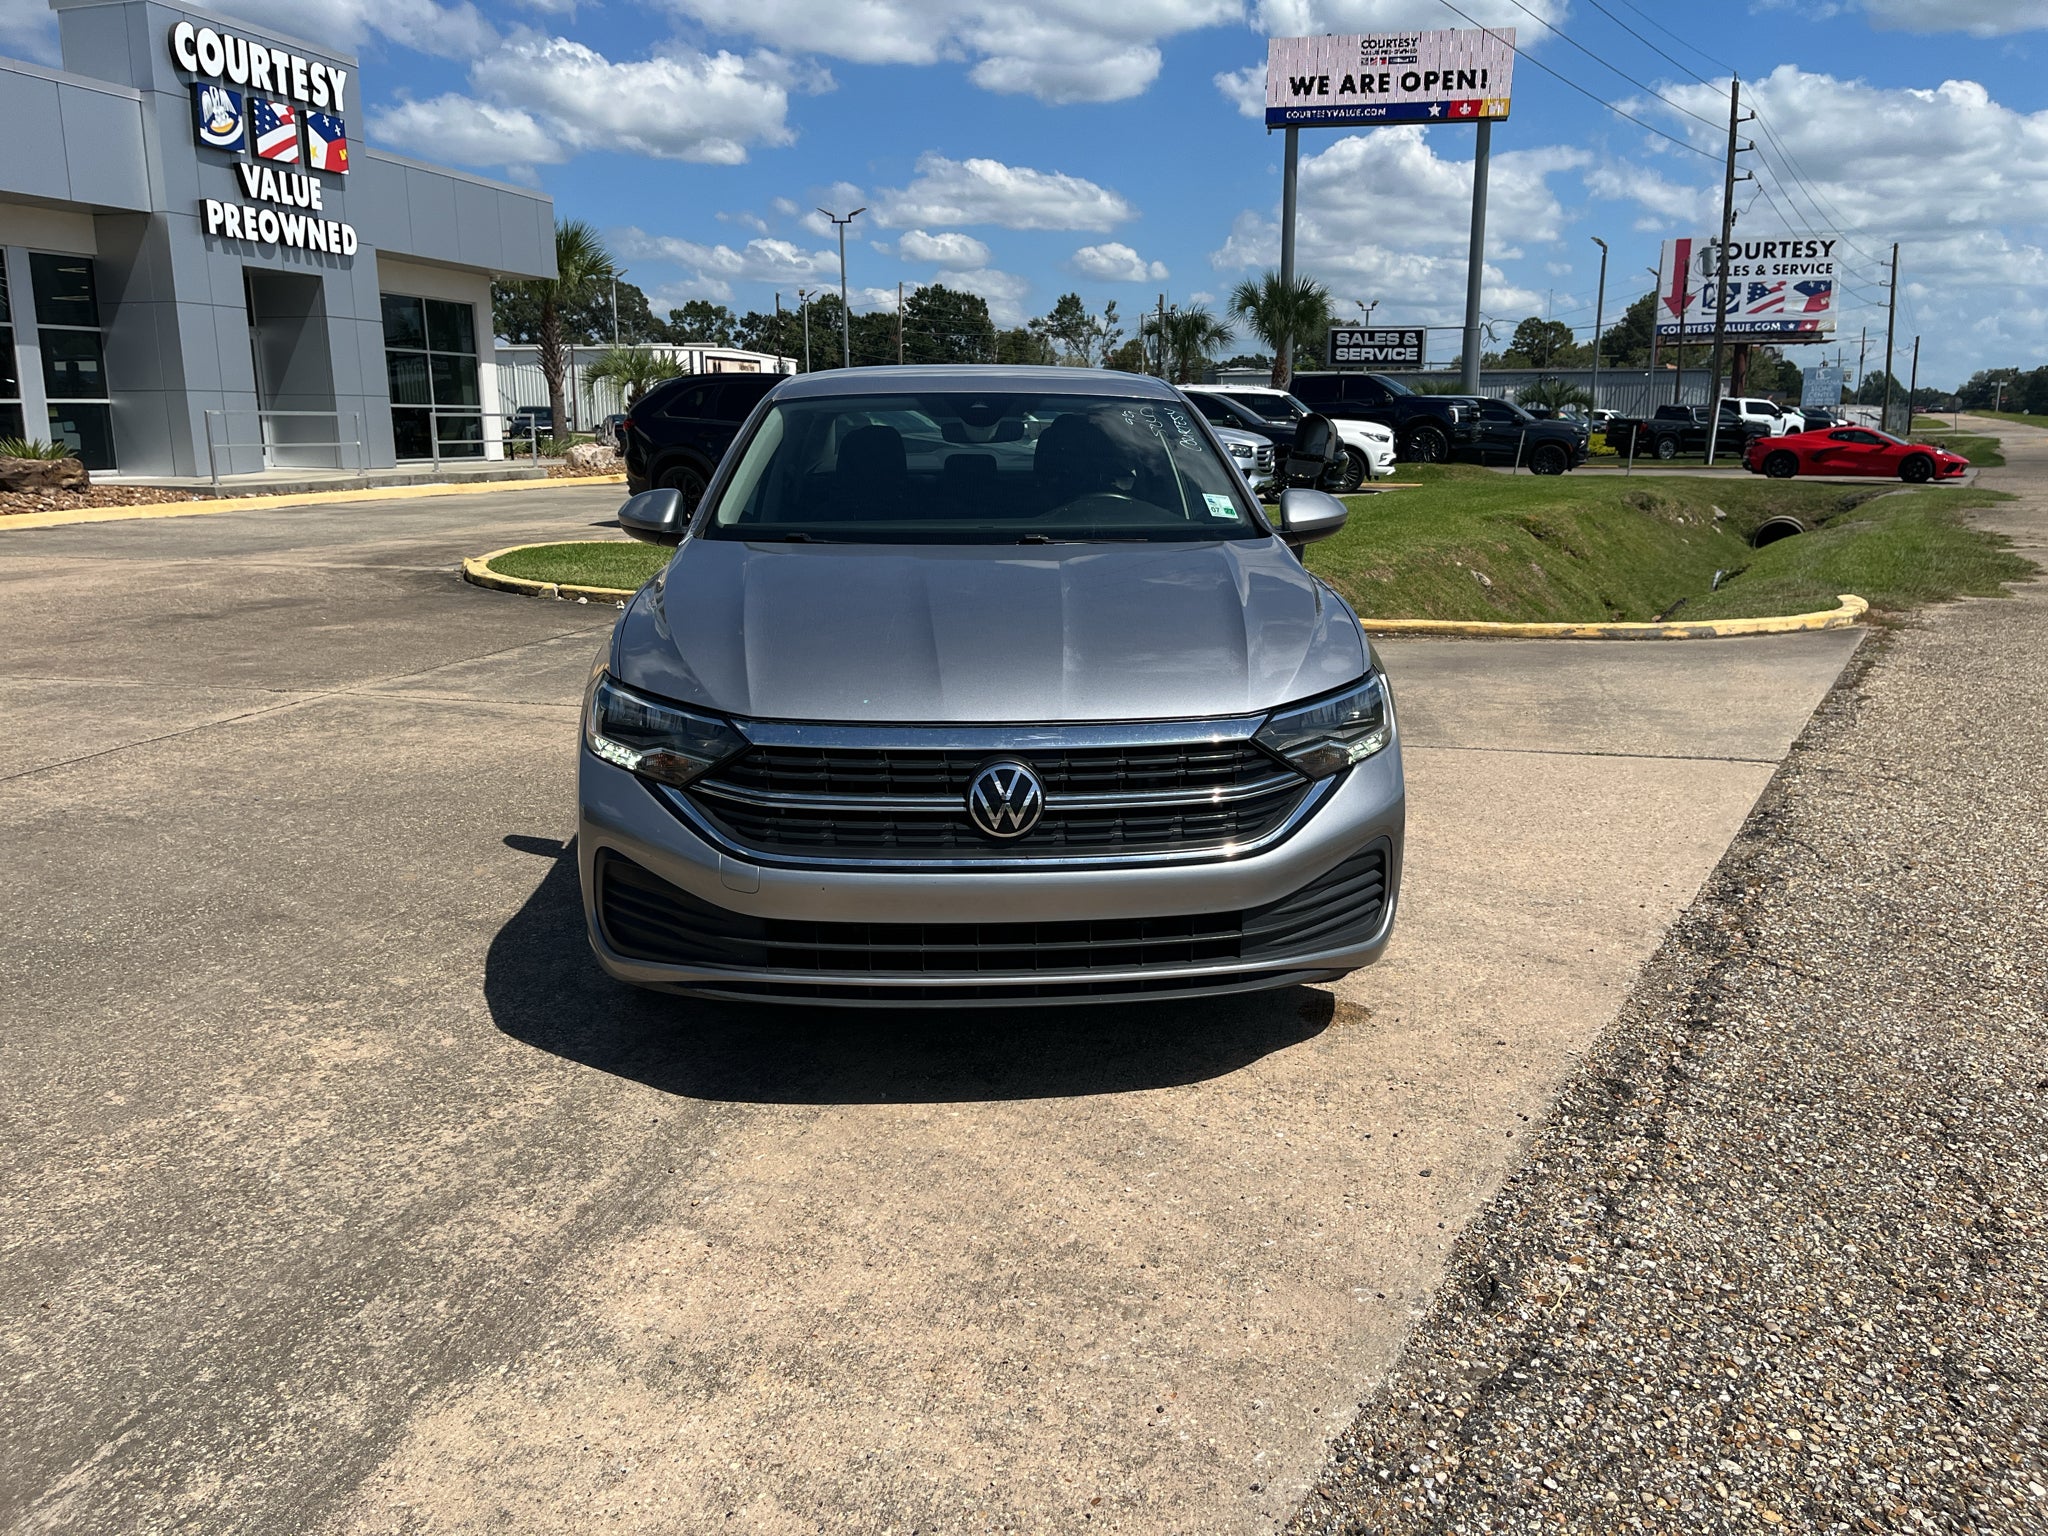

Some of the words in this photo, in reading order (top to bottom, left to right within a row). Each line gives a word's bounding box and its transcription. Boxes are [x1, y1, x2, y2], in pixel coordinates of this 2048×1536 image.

[1361, 37, 1418, 49] COURTESY
[173, 21, 348, 112] COURTESY
[1289, 75, 1330, 96] WE
[1339, 72, 1390, 94] ARE
[1401, 68, 1488, 92] OPEN!
[239, 162, 324, 211] VALUE
[206, 198, 358, 256] PREOWNED
[1755, 264, 1766, 276] &
[1772, 263, 1833, 275] SERVICE
[1336, 332, 1400, 346] SALES
[1403, 332, 1419, 346] &
[1335, 347, 1419, 361] SERVICE
